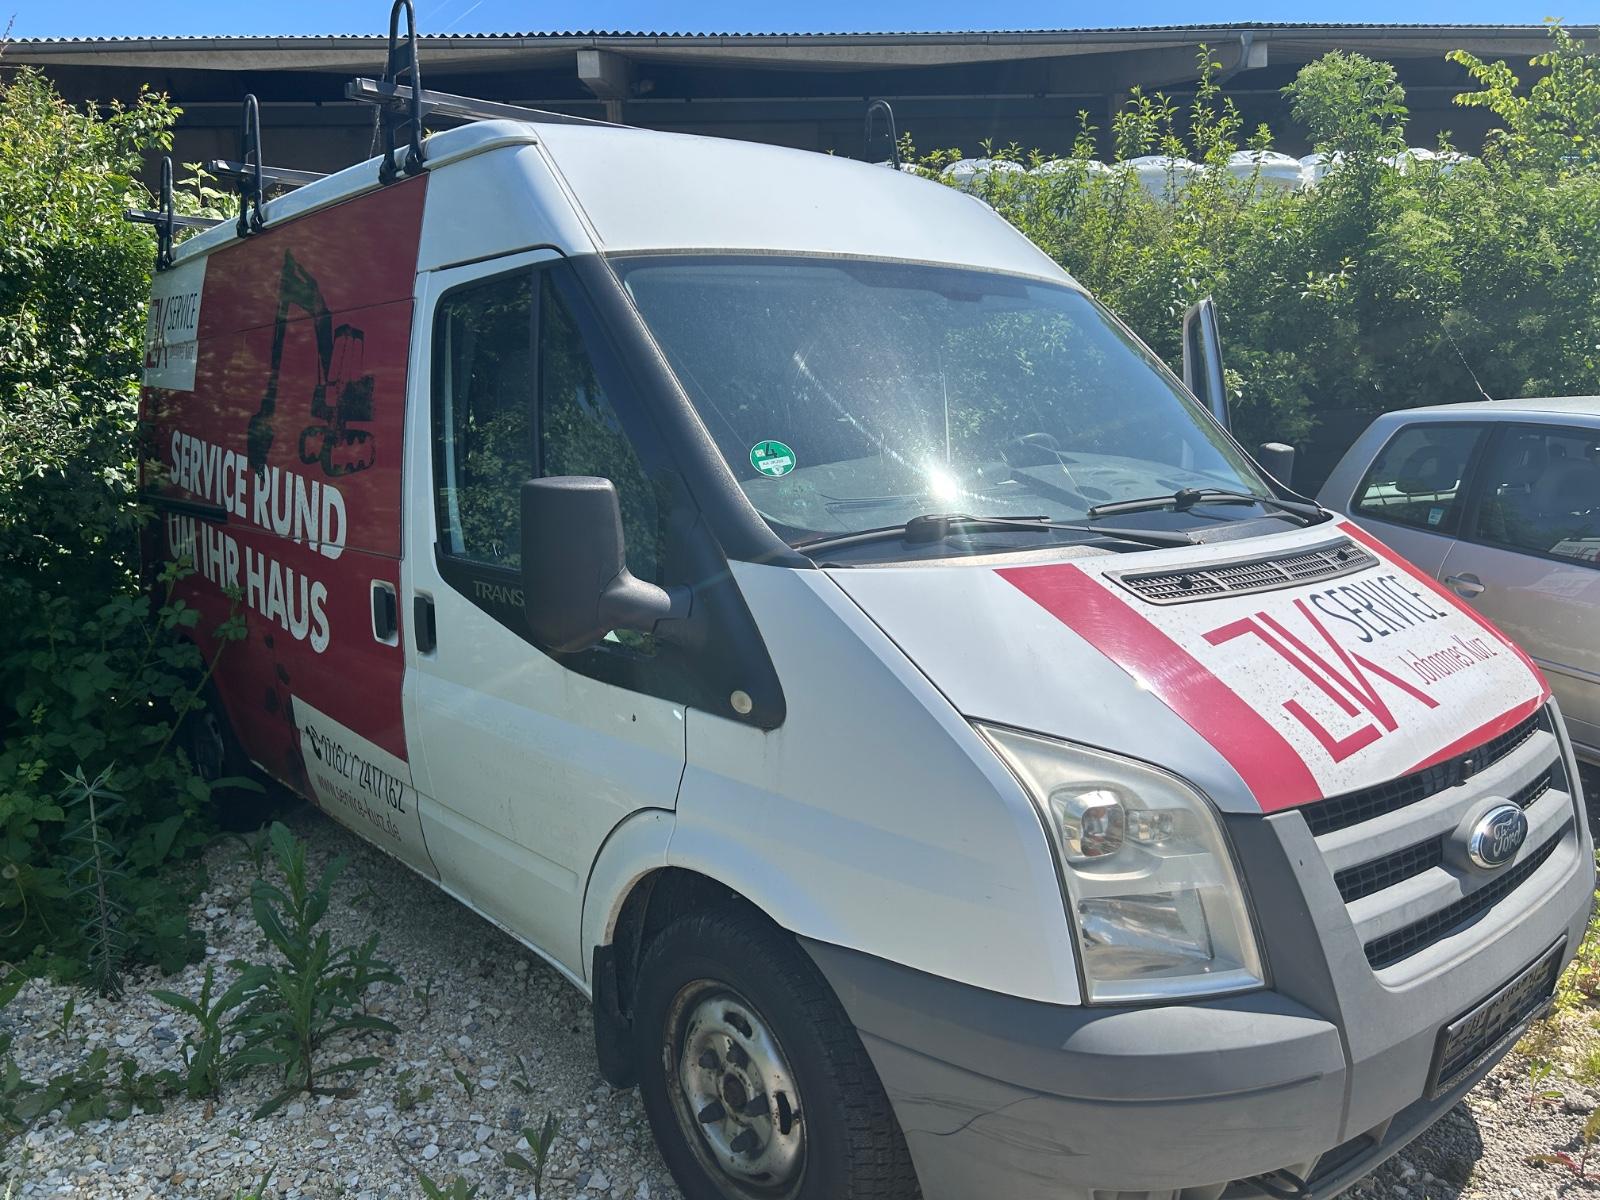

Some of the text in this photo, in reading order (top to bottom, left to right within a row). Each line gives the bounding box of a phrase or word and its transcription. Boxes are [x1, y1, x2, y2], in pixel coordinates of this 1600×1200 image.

[167, 292, 198, 330] SERVICE
[170, 430, 347, 560] SERVICE RUND
[168, 511, 330, 654] UM IHR HAUS
[472, 580, 526, 607] TRANS
[1309, 575, 1448, 643] SERVICE
[1397, 634, 1498, 685] Johannes Kurz
[1493, 818, 1521, 857] Ford
